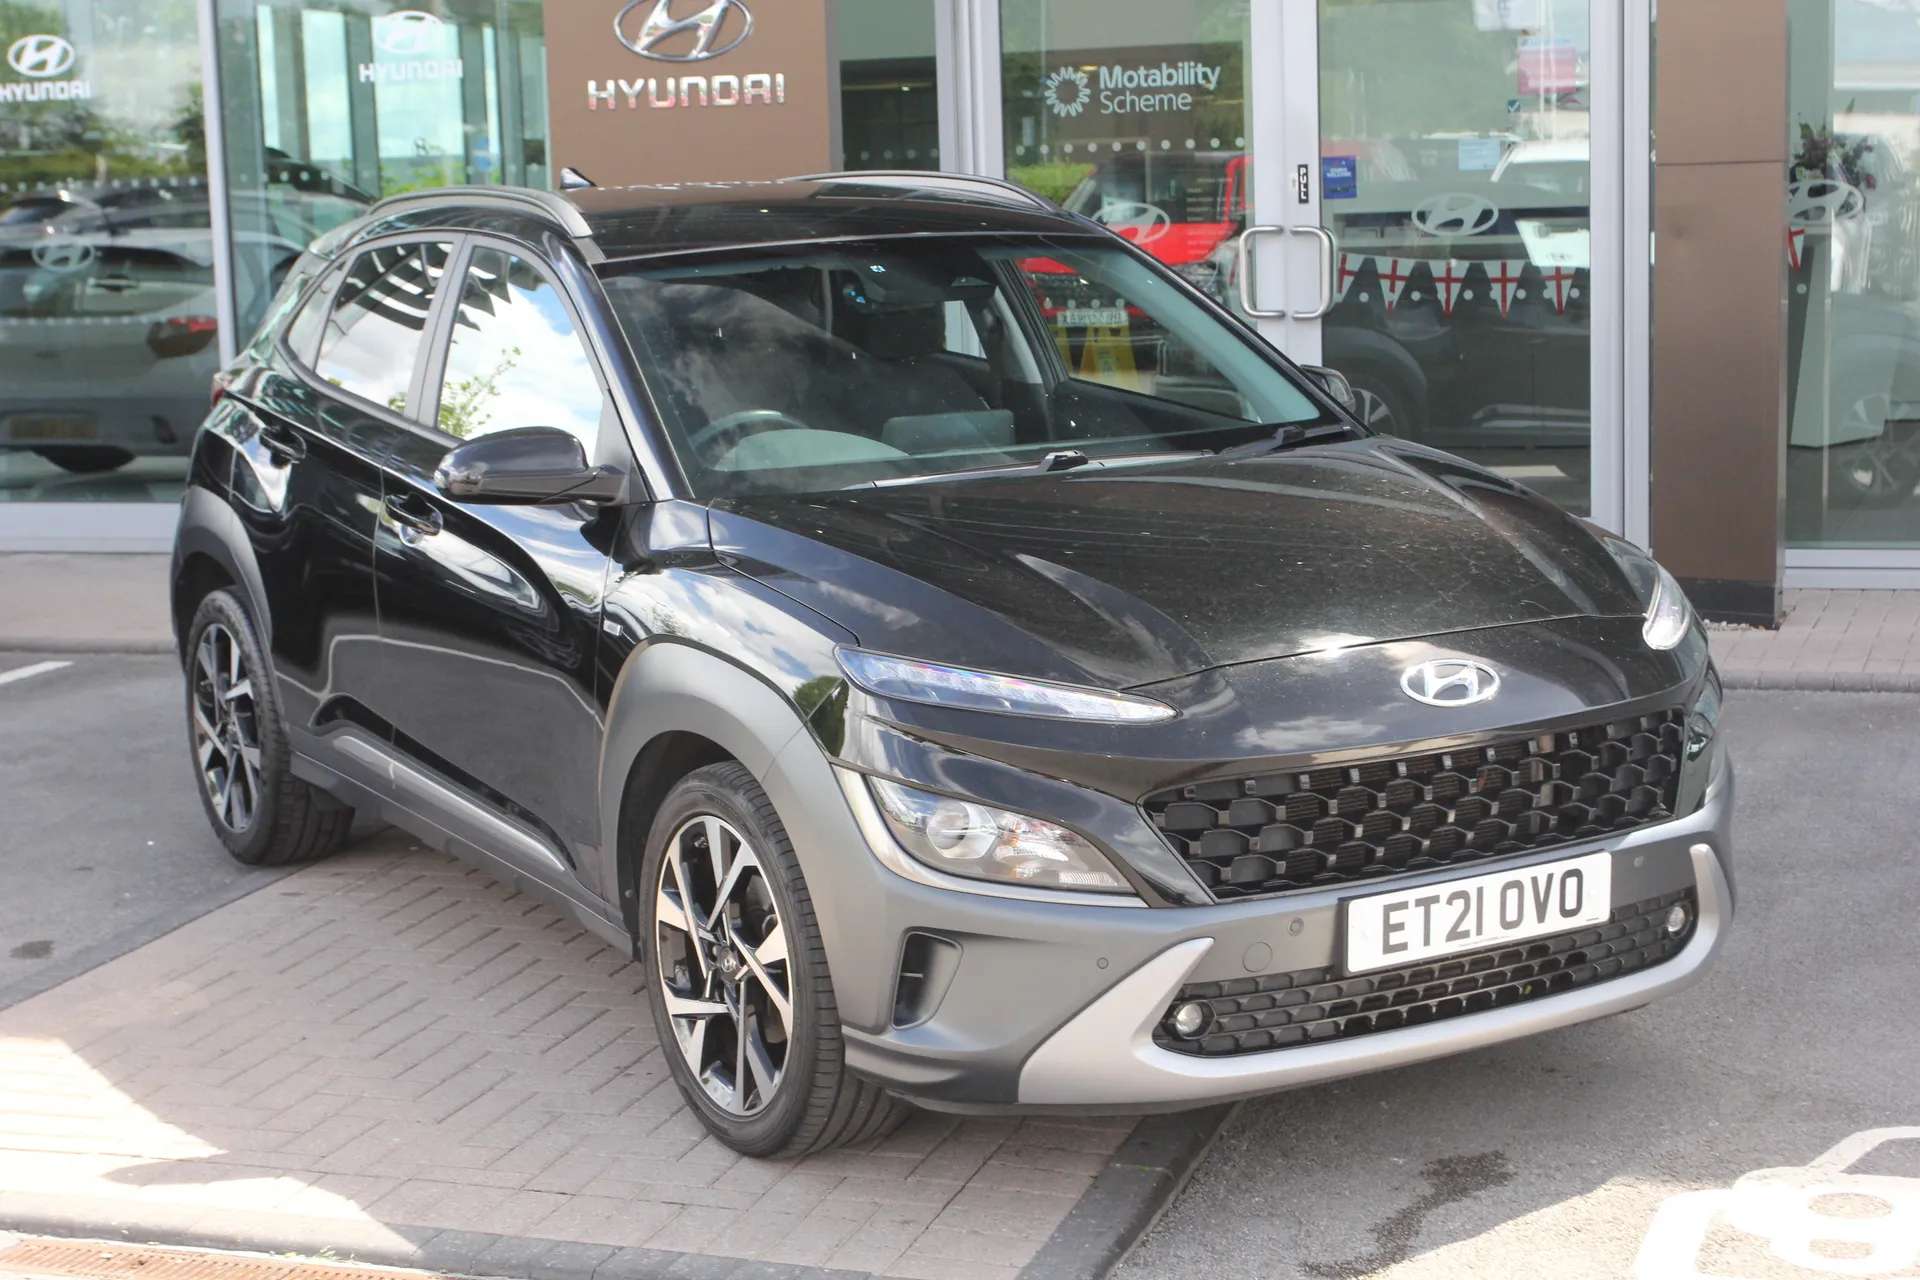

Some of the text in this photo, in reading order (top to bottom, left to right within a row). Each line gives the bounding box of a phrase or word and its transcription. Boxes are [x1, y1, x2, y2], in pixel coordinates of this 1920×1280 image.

[359, 59, 463, 83] HYUNDAI
[1100, 62, 1220, 90] Motability
[0, 81, 91, 102] HYUNDAI
[587, 73, 785, 110] HYUNDAI
[1100, 91, 1192, 114] Scheme
[1382, 868, 1584, 955] ET21 OVO
